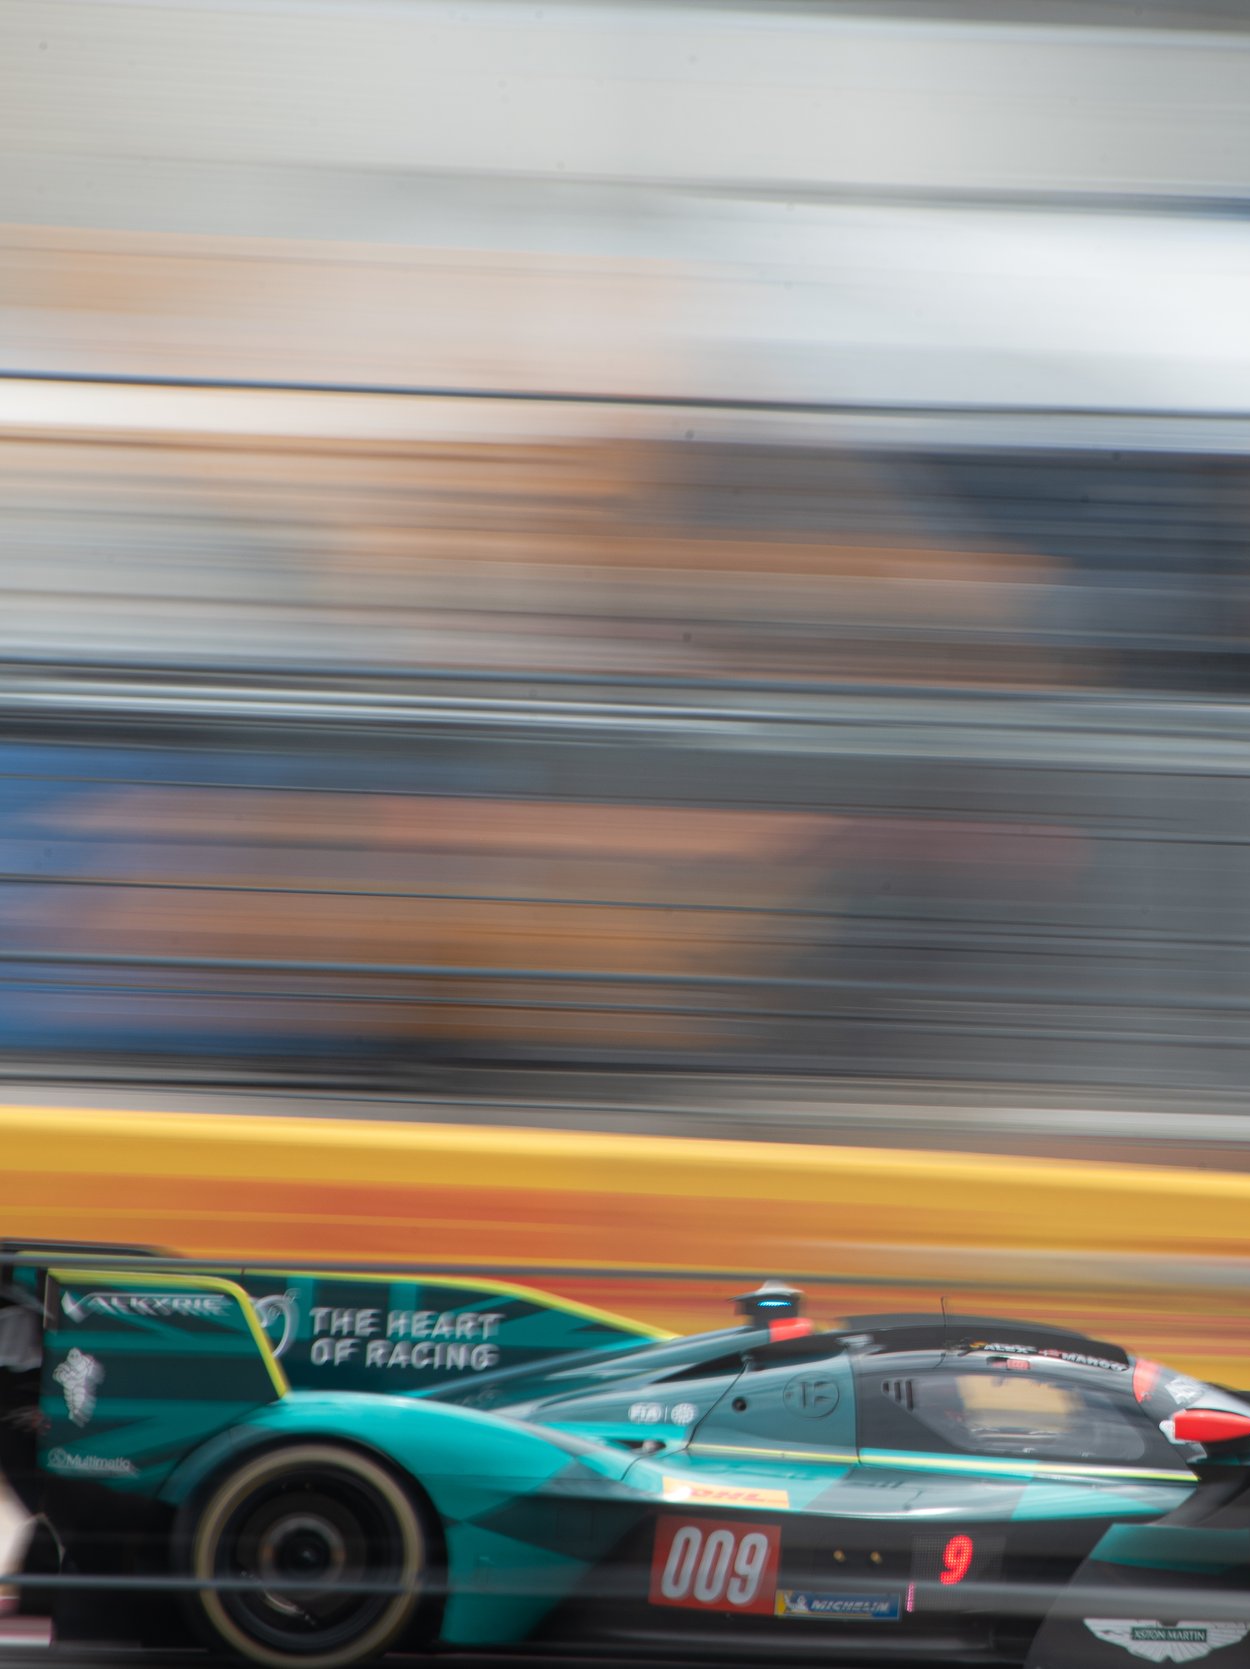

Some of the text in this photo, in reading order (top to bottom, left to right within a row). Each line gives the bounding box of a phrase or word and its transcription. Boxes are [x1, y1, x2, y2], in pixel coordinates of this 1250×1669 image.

[61, 1290, 232, 1323] VALKYRIE
[309, 1307, 506, 1341] THE HEART
[310, 1337, 501, 1371] OF RACING
[661, 1526, 769, 1606] 009
[940, 1534, 973, 1585] 9
[810, 1598, 891, 1612] MICHELIN
[1134, 1629, 1206, 1642] ASTON MARTIN
